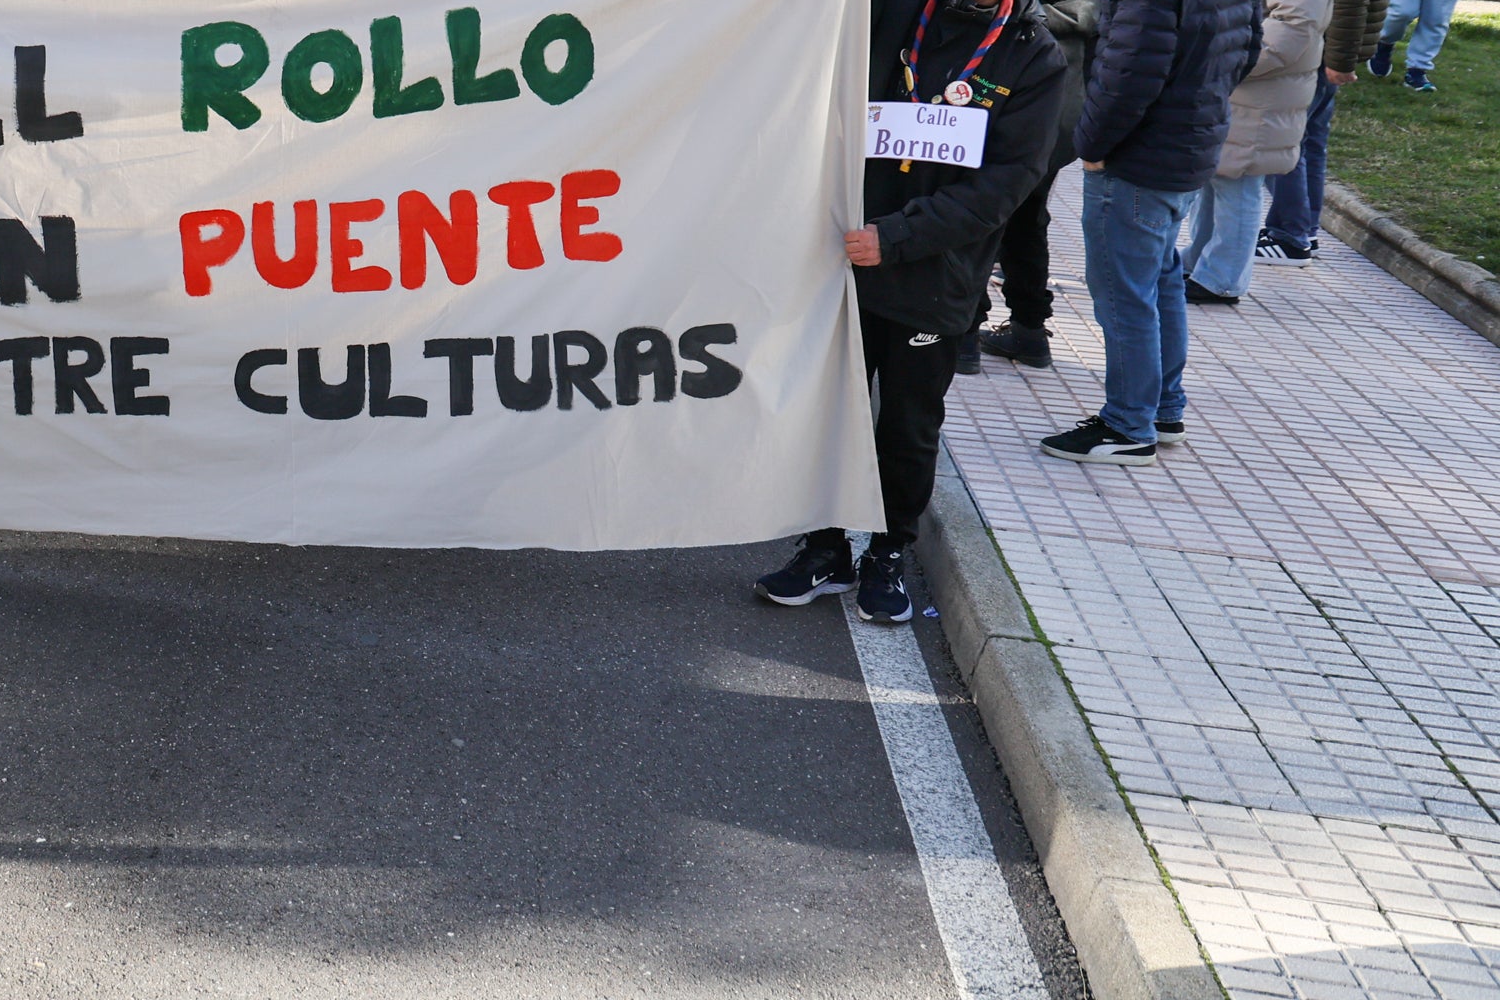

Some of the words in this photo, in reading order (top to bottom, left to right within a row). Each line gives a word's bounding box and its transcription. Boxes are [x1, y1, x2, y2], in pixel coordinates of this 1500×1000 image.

[180, 6, 595, 133] ROLLO
[874, 128, 966, 163] Borneo
[916, 106, 957, 127] Calle
[179, 168, 624, 297] PUENTE
[915, 332, 939, 343] NIKE
[234, 323, 743, 420] CULTURAS
